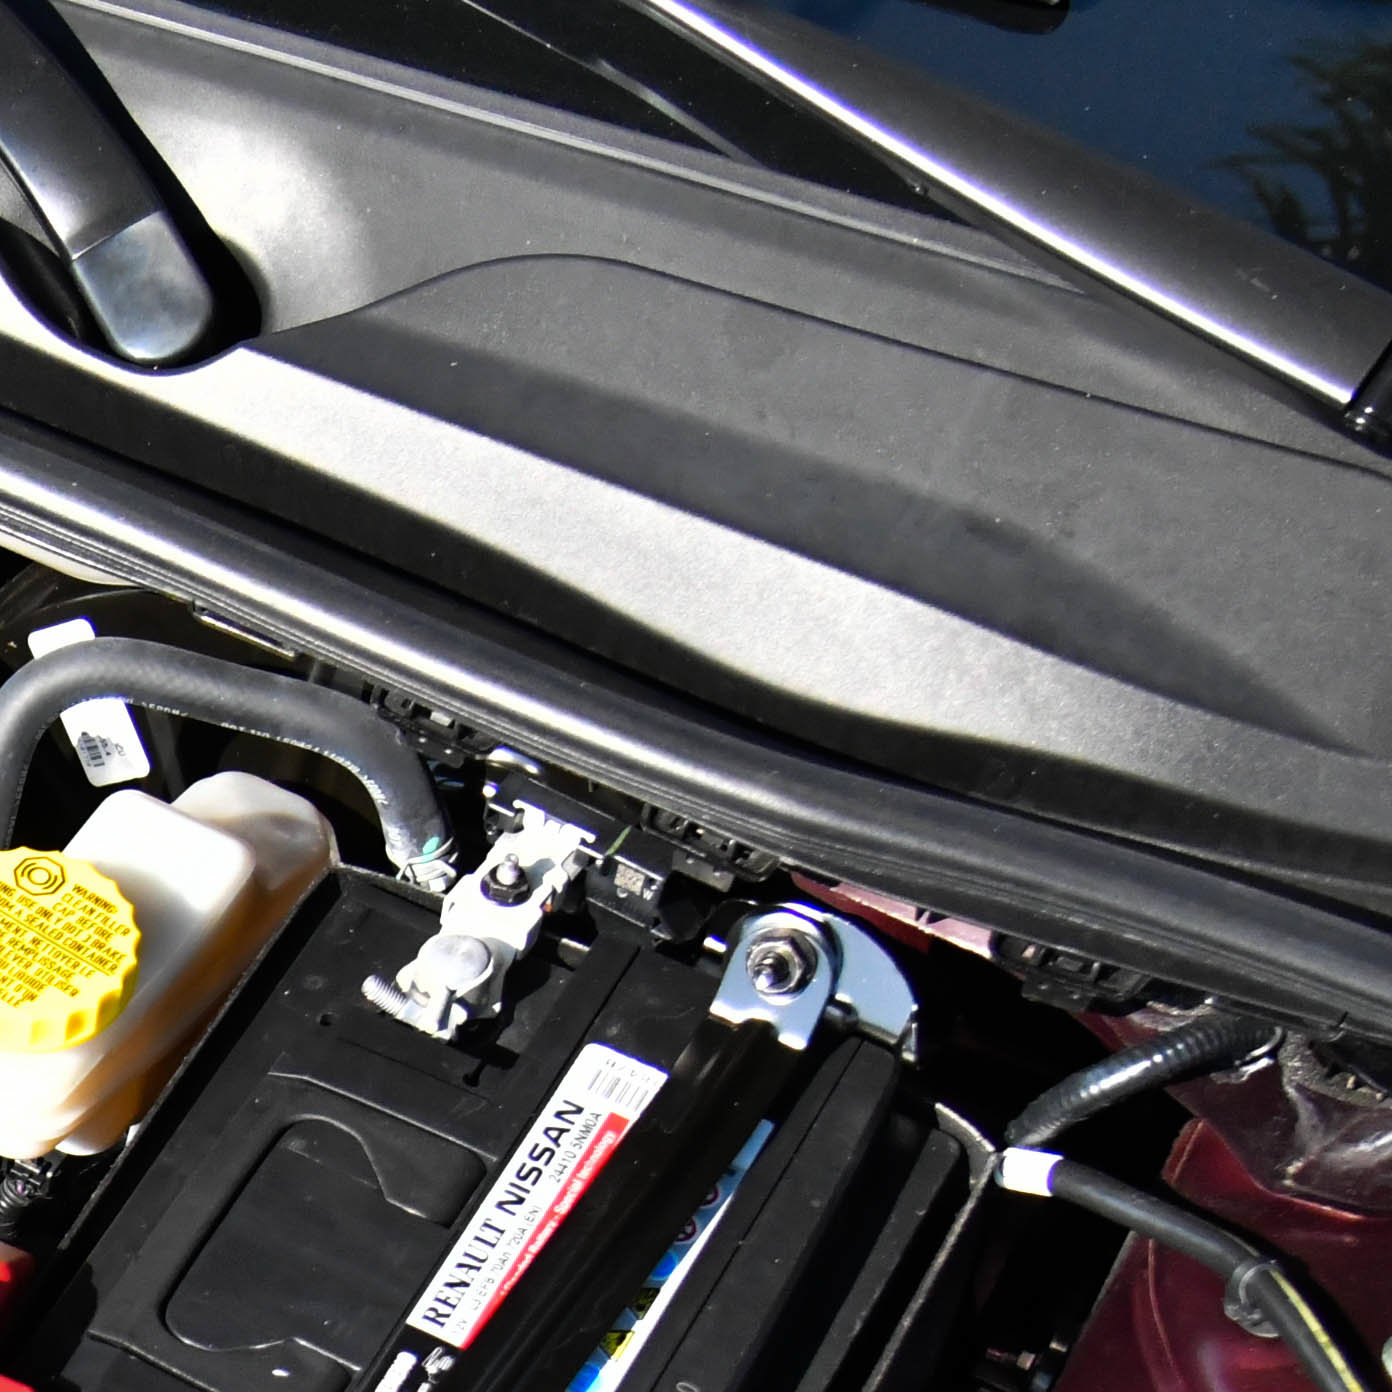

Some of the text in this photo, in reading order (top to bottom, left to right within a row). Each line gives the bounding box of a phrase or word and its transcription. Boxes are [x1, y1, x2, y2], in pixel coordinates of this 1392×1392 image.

[12, 906, 25, 917] A
[22, 912, 64, 941] SEALED
[14, 893, 37, 910] USE
[33, 905, 62, 925] ONLY
[60, 921, 83, 938] DOT
[88, 938, 126, 964] BRAKE
[51, 901, 114, 942] CAP BEFORE
[60, 892, 131, 937] CLEAN FILLER
[6, 936, 76, 981] REMPLISSAGE
[547, 1148, 577, 1184] 24410
[421, 1100, 585, 1329] RENAULT NISSAN
[552, 1177, 583, 1216] Special
